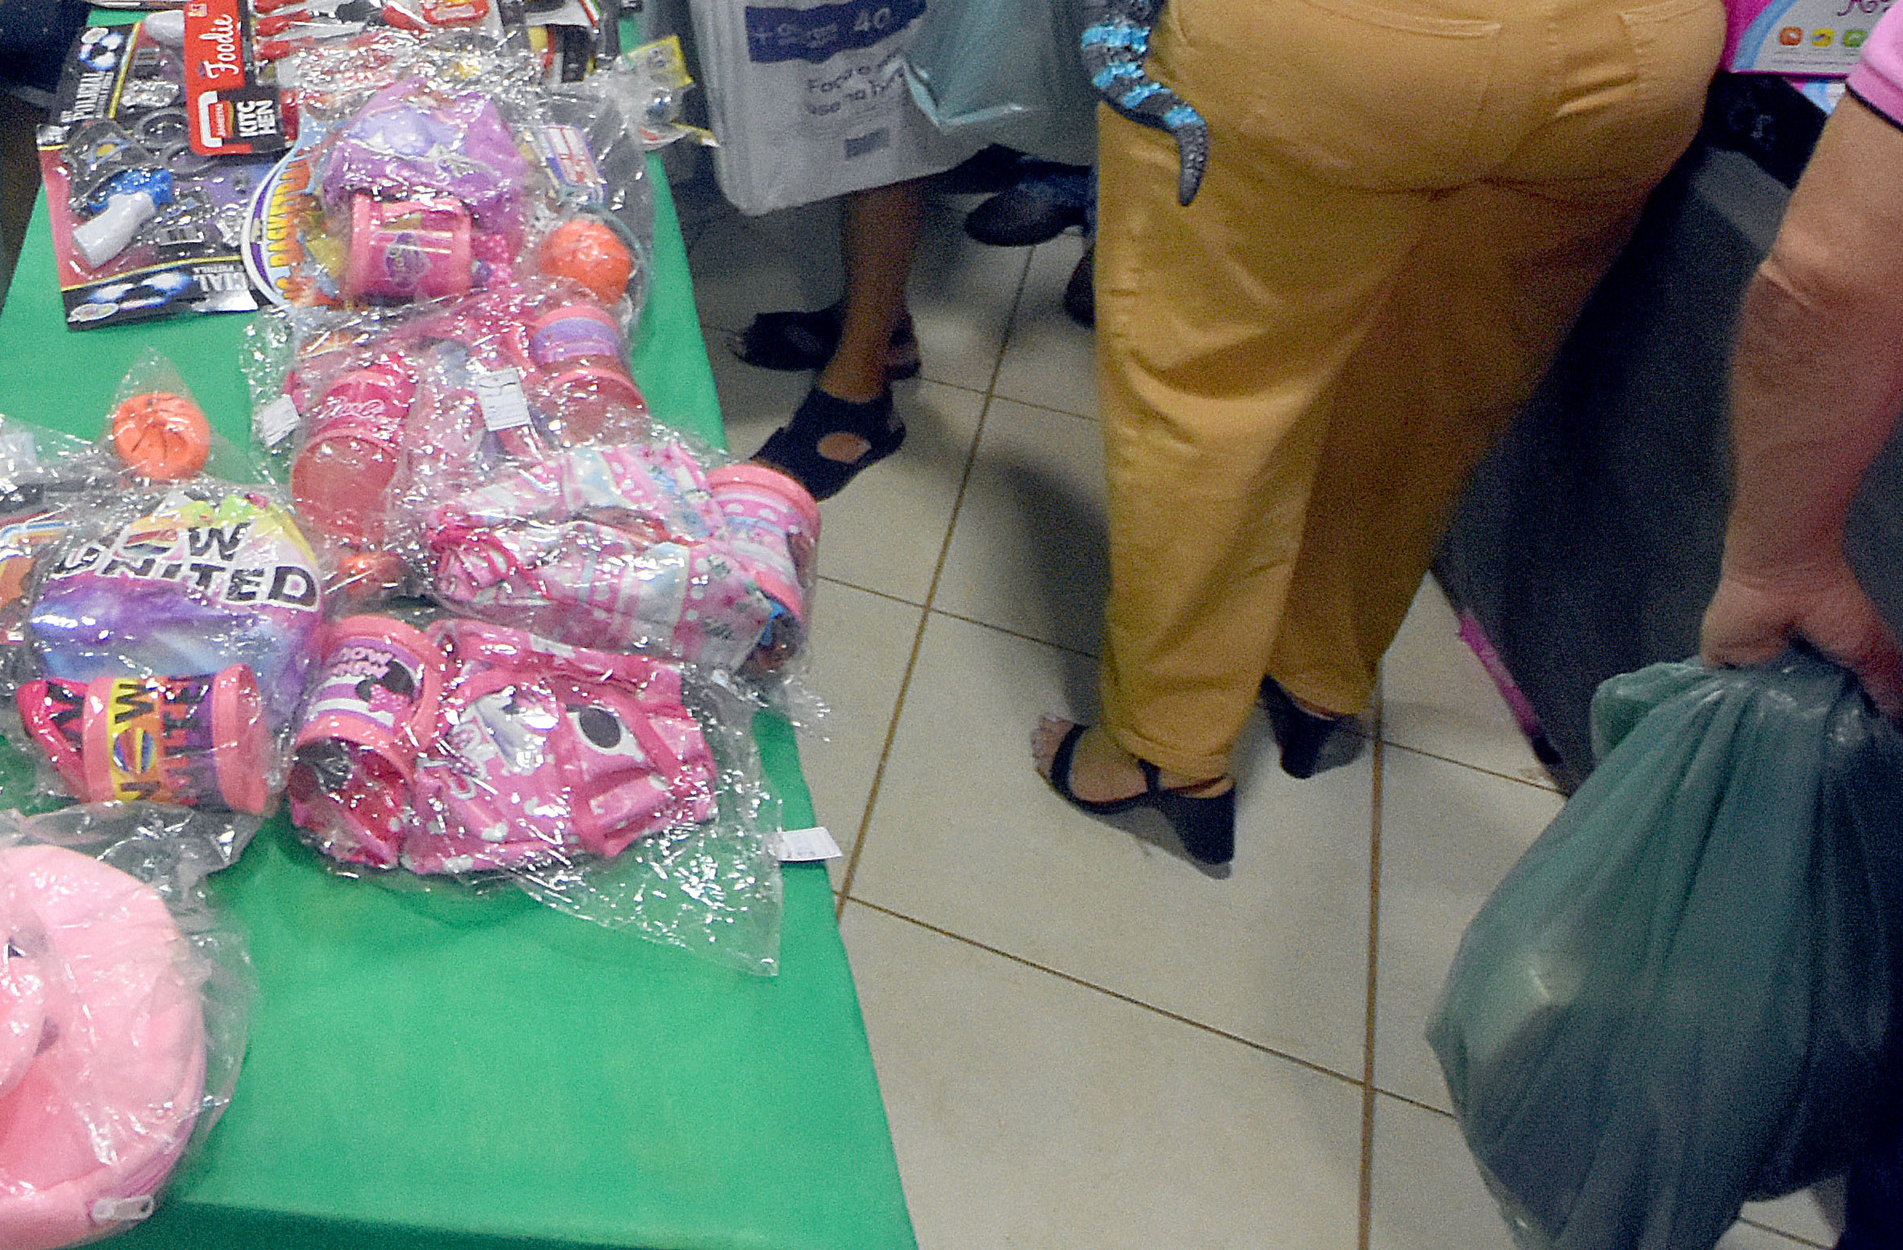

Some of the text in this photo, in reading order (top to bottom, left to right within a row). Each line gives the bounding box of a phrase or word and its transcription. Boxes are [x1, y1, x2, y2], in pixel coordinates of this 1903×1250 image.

[198, 14, 239, 79] Foodie
[236, 99, 258, 137] KITC
[255, 99, 277, 136] HEN
[198, 272, 248, 292] CIAL
